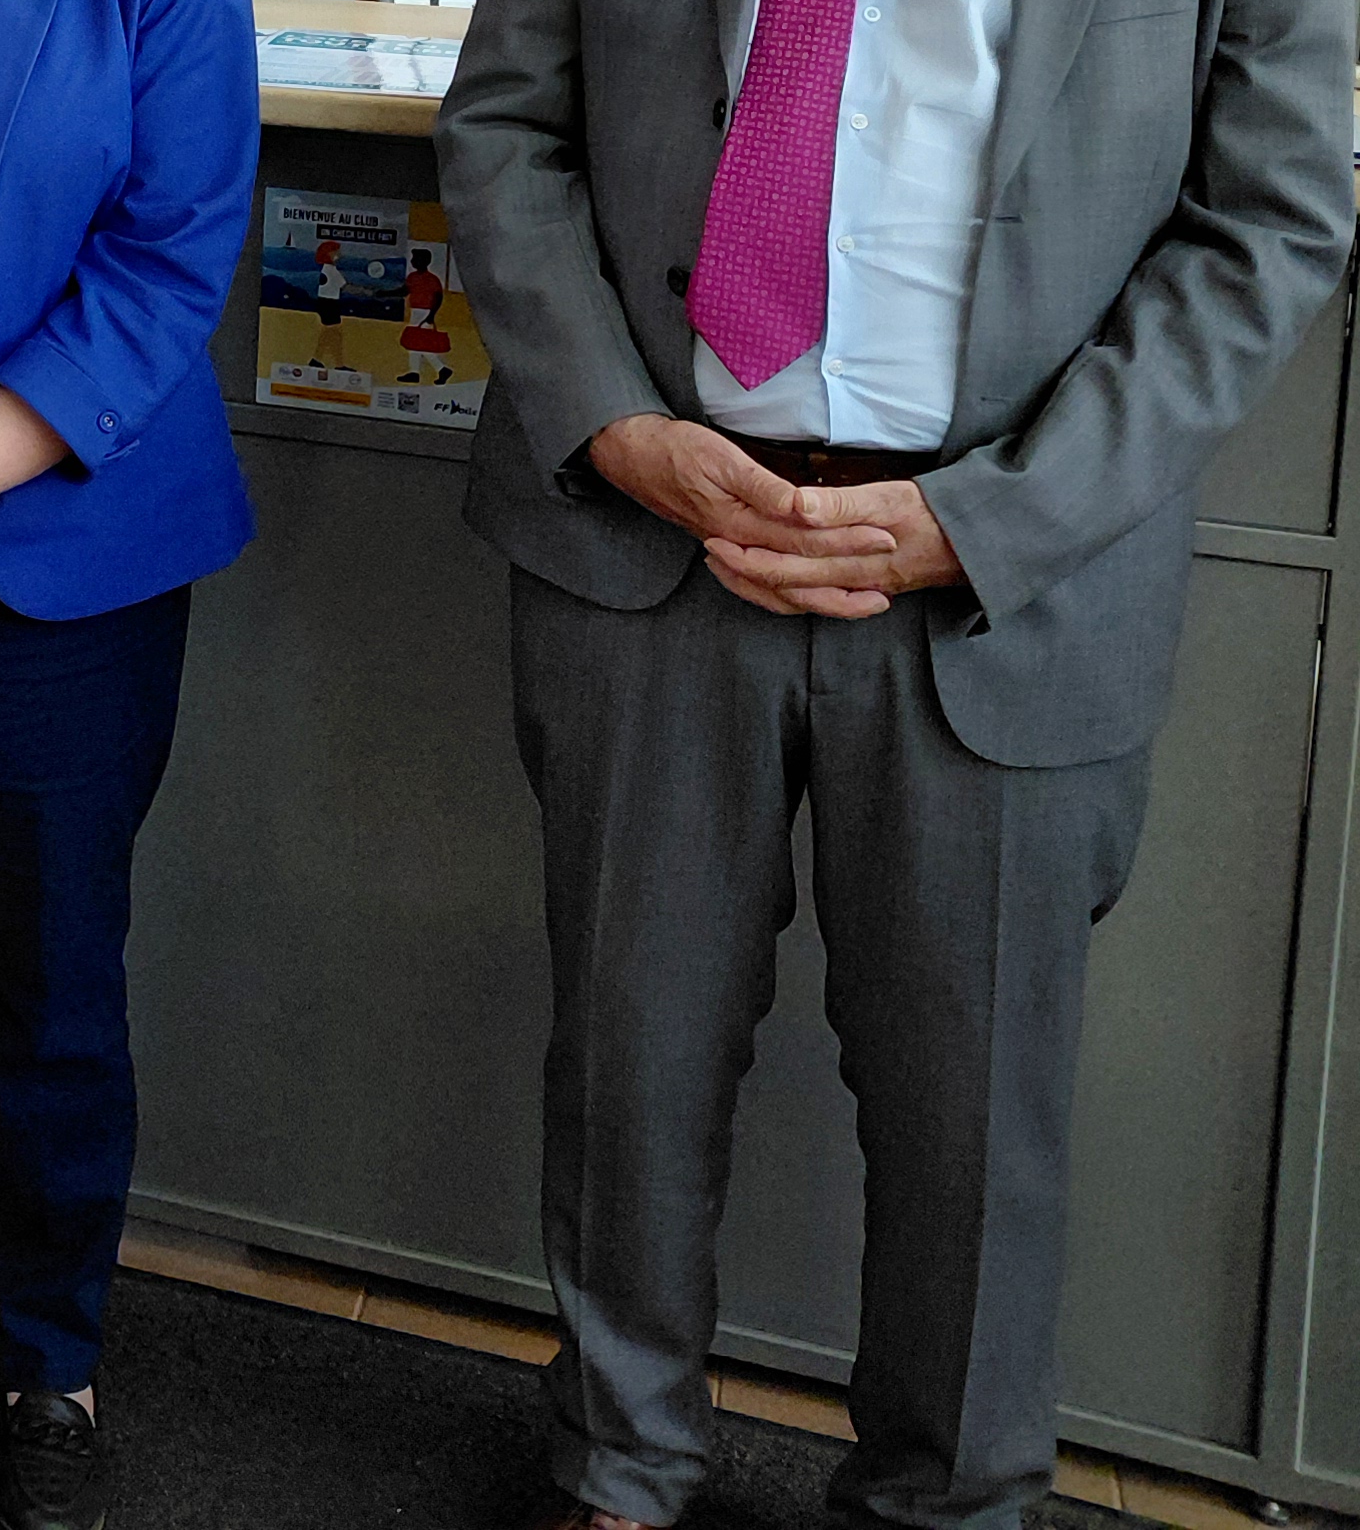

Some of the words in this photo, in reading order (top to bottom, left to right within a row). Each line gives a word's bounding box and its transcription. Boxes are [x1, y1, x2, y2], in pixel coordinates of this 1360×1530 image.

[283, 207, 336, 222] BIENVENUE
[338, 213, 351, 225] AU
[354, 214, 379, 227] CLUB
